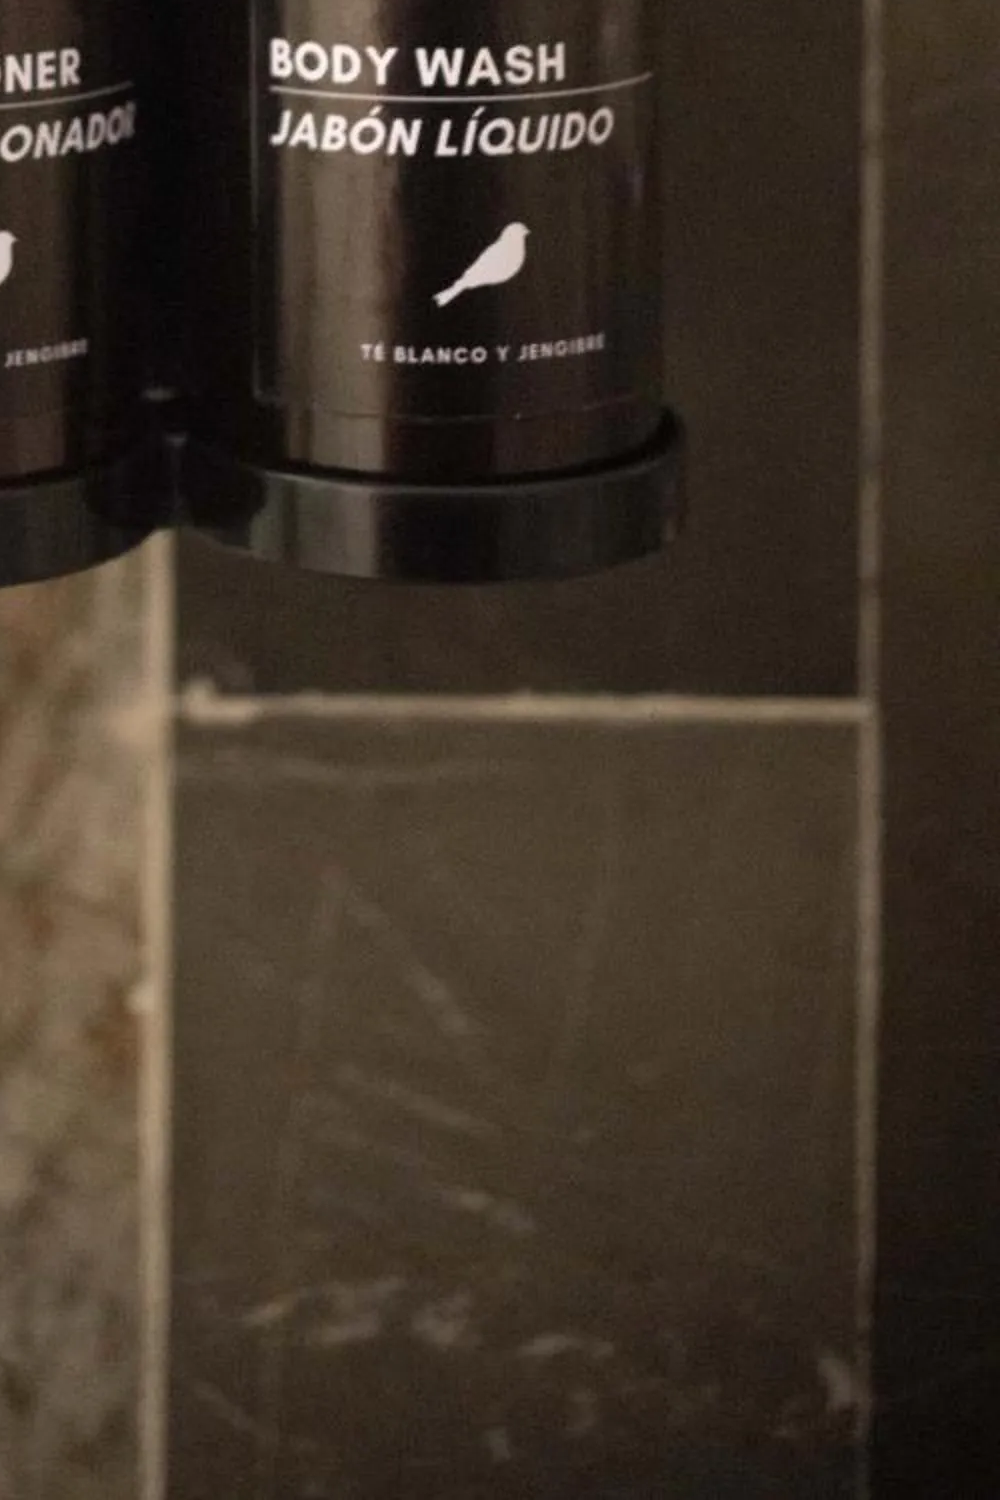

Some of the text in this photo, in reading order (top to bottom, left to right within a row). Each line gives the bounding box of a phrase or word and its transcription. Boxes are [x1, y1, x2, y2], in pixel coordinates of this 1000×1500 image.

[269, 37, 567, 88] BODY WASH
[268, 104, 615, 158] JABÓN LÍQUIDO
[360, 341, 386, 362] TÉ
[393, 345, 488, 365] BLANCO
[496, 345, 510, 362] Y
